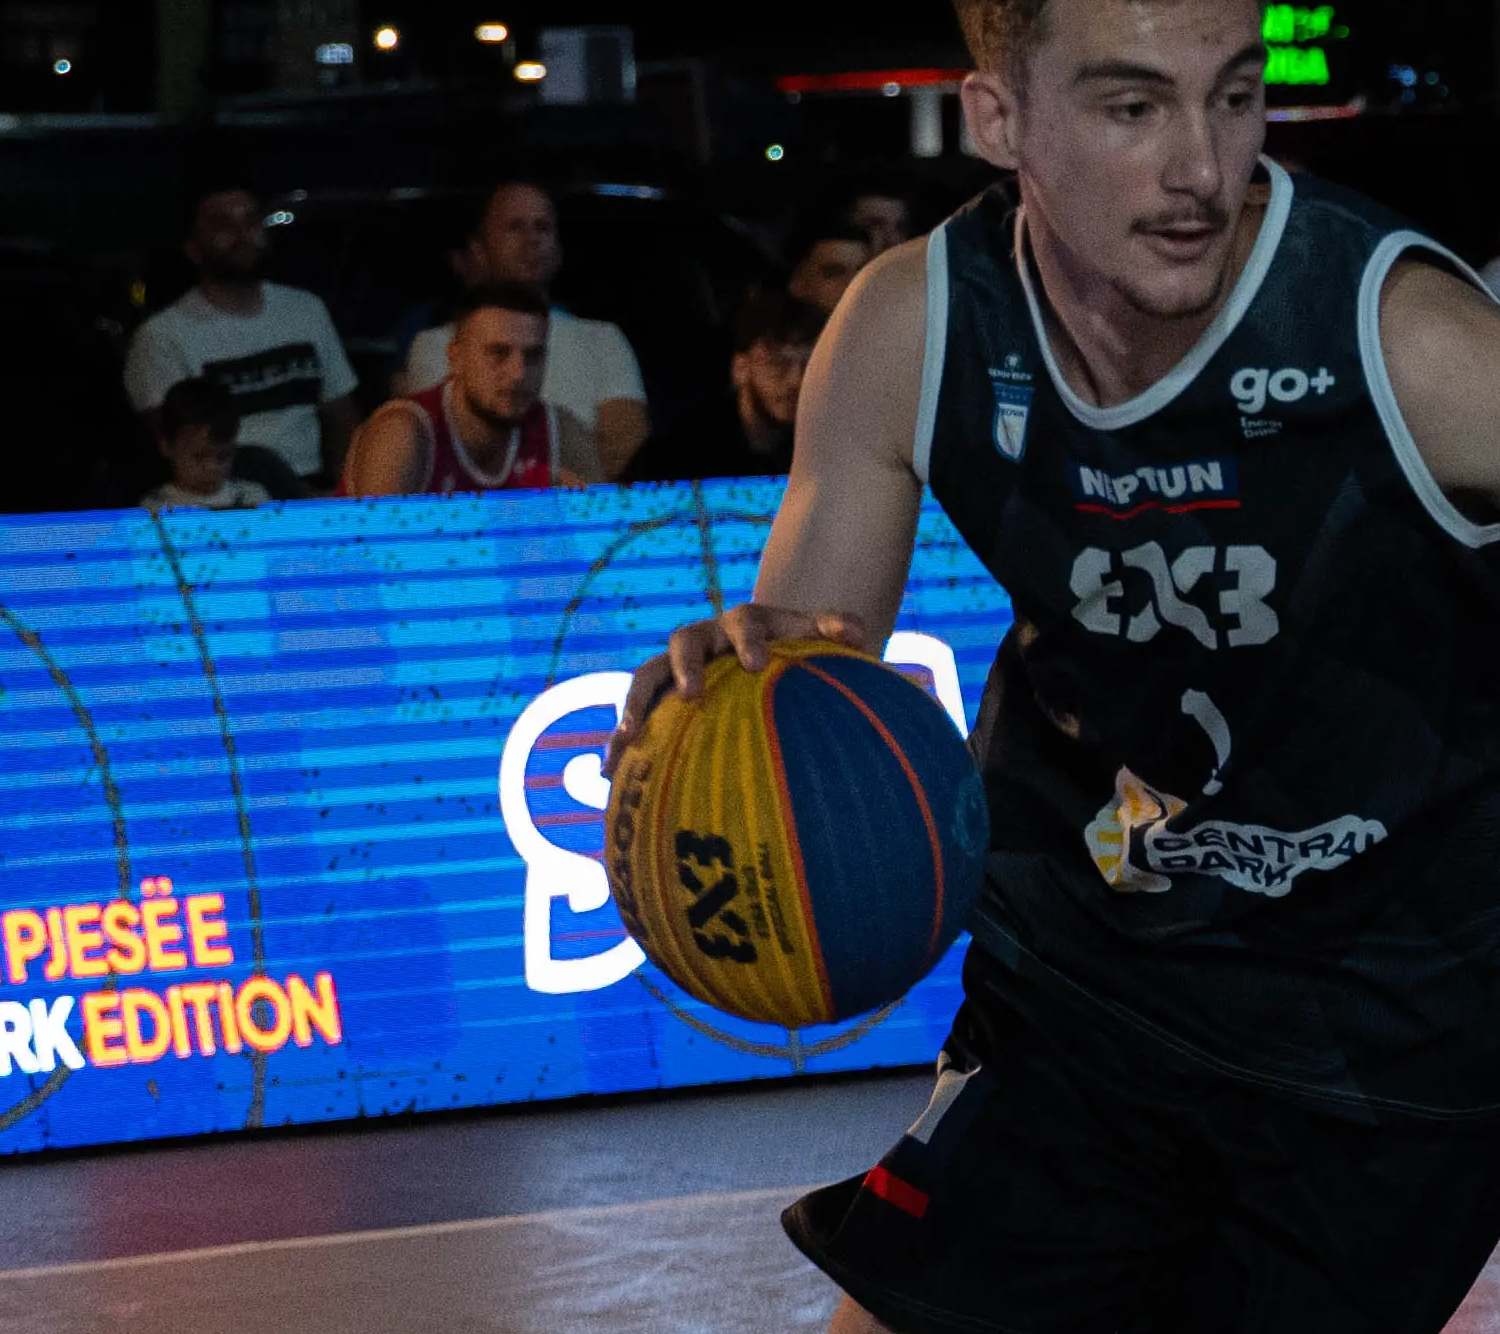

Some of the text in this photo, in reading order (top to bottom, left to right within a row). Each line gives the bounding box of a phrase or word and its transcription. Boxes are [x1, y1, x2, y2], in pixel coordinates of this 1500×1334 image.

[1229, 365, 1336, 415] go+
[2, 875, 188, 986] PJESË
[185, 891, 235, 967] E
[80, 971, 343, 1067] EDITION
